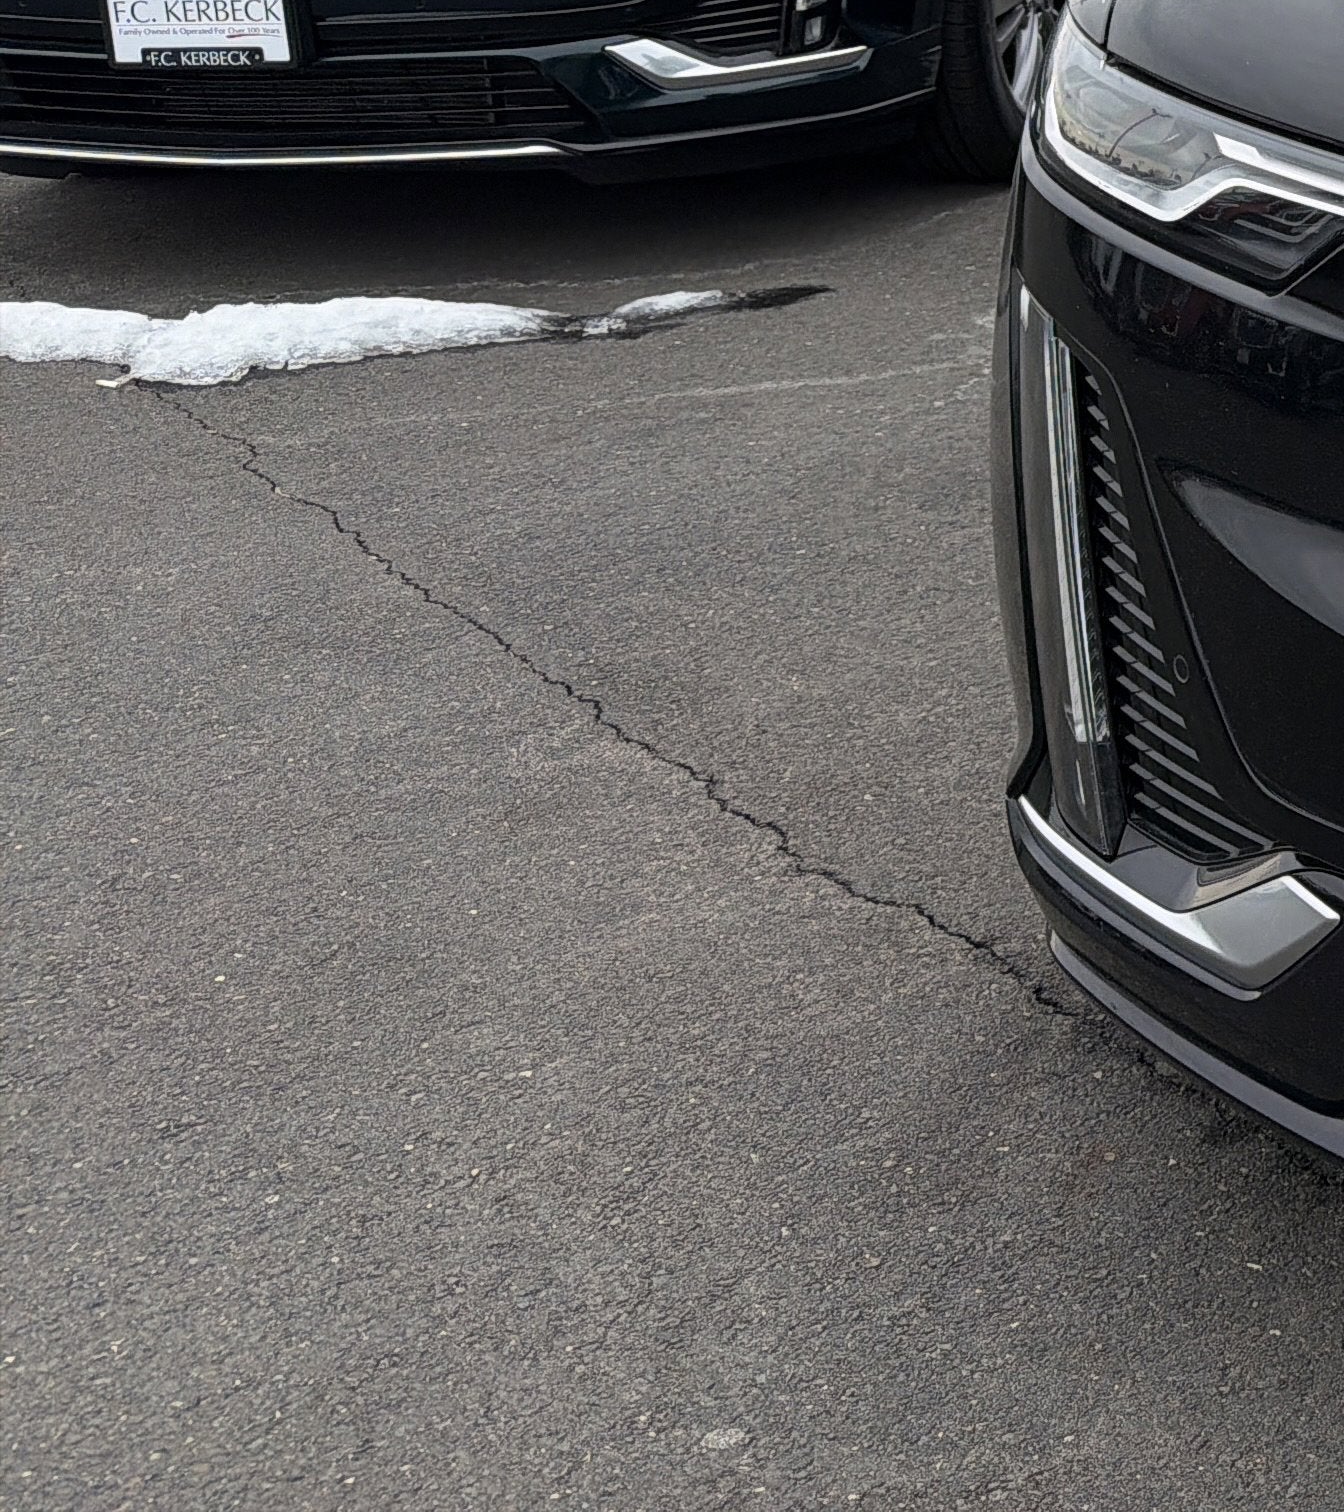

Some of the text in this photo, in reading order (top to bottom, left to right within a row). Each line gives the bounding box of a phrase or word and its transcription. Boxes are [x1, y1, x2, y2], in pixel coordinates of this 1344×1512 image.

[113, 0, 282, 24] F.C. KERBECK
[118, 28, 142, 37] Family
[180, 28, 213, 37] Operated
[150, 51, 251, 66] F.C. KERBECK
